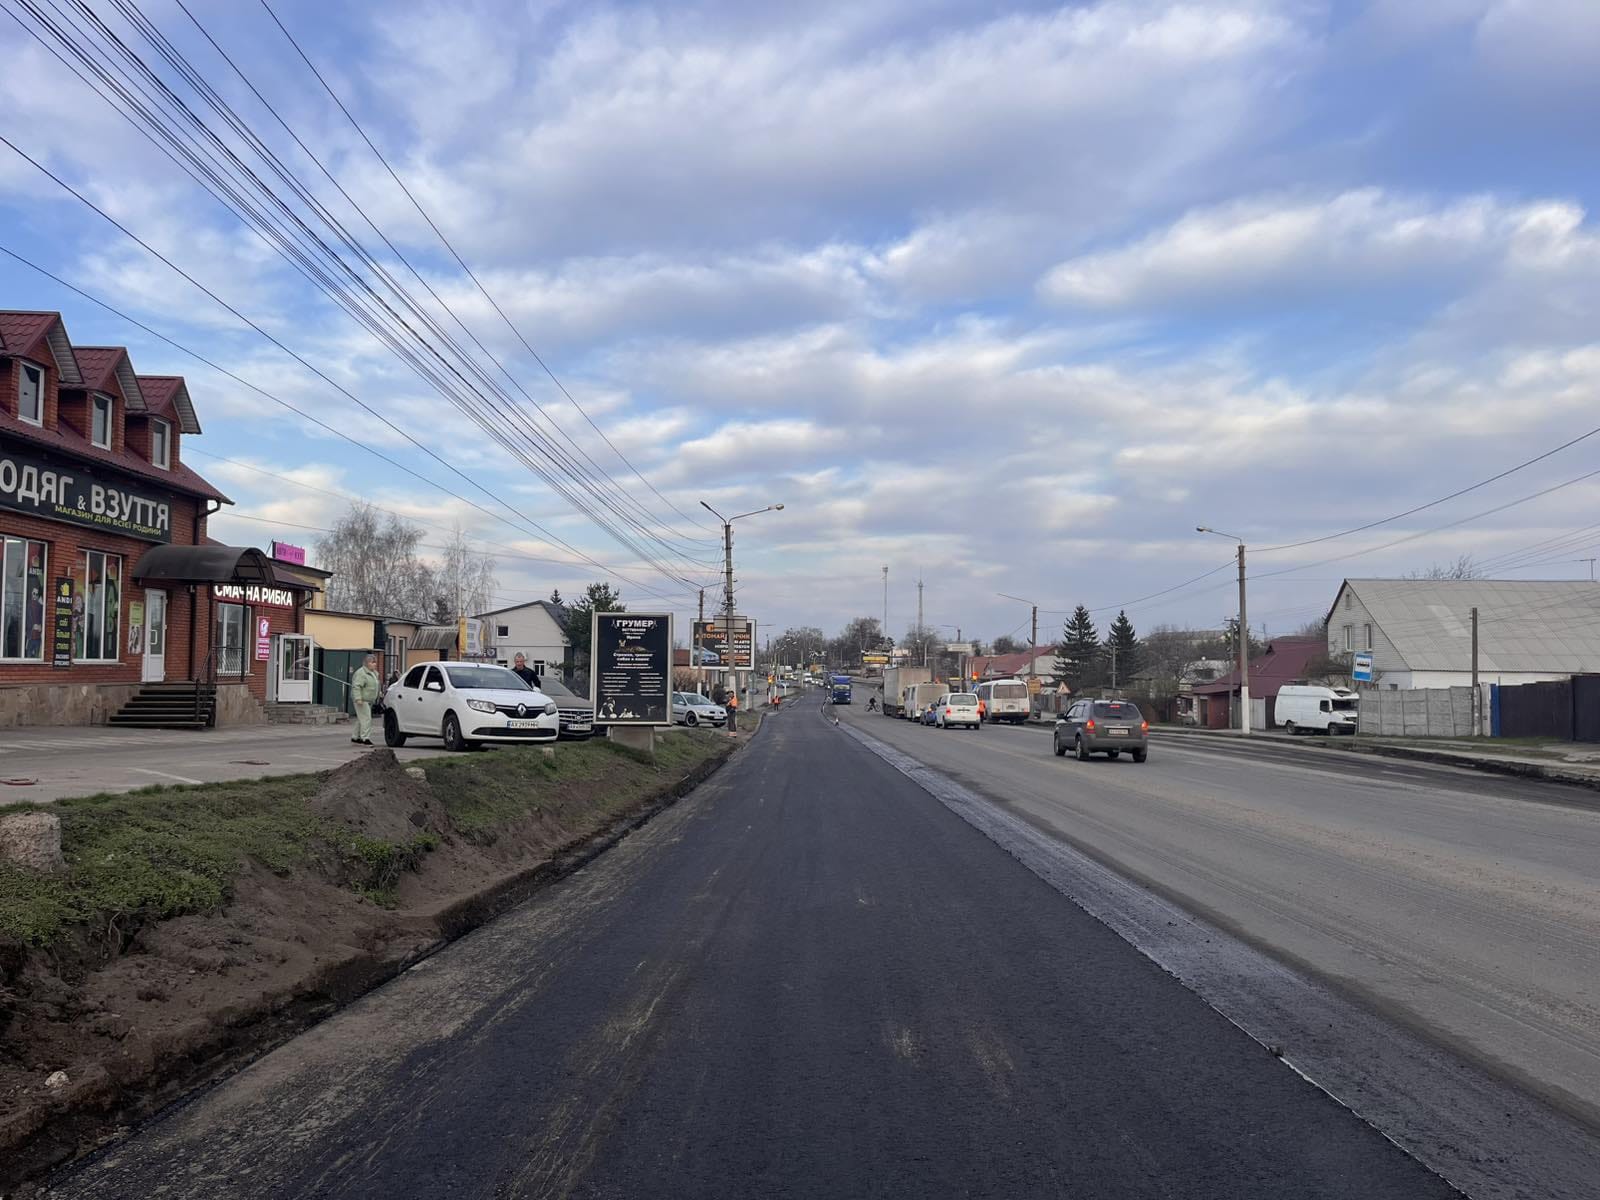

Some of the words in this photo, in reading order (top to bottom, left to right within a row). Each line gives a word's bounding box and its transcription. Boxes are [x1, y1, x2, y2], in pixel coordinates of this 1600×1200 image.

[0, 459, 74, 507] ОДЯГ
[77, 495, 86, 510] &
[91, 484, 169, 531] ВЗУТТЯ
[55, 505, 94, 521] МАГАЗИН
[94, 514, 112, 525] ДЛЯ
[113, 518, 132, 530] ВСІЄЇ
[132, 523, 161, 536] РОДИНИ
[56, 595, 73, 604] ANDI
[261, 587, 293, 606] РИБКА
[616, 619, 654, 627] ГРУМЕР
